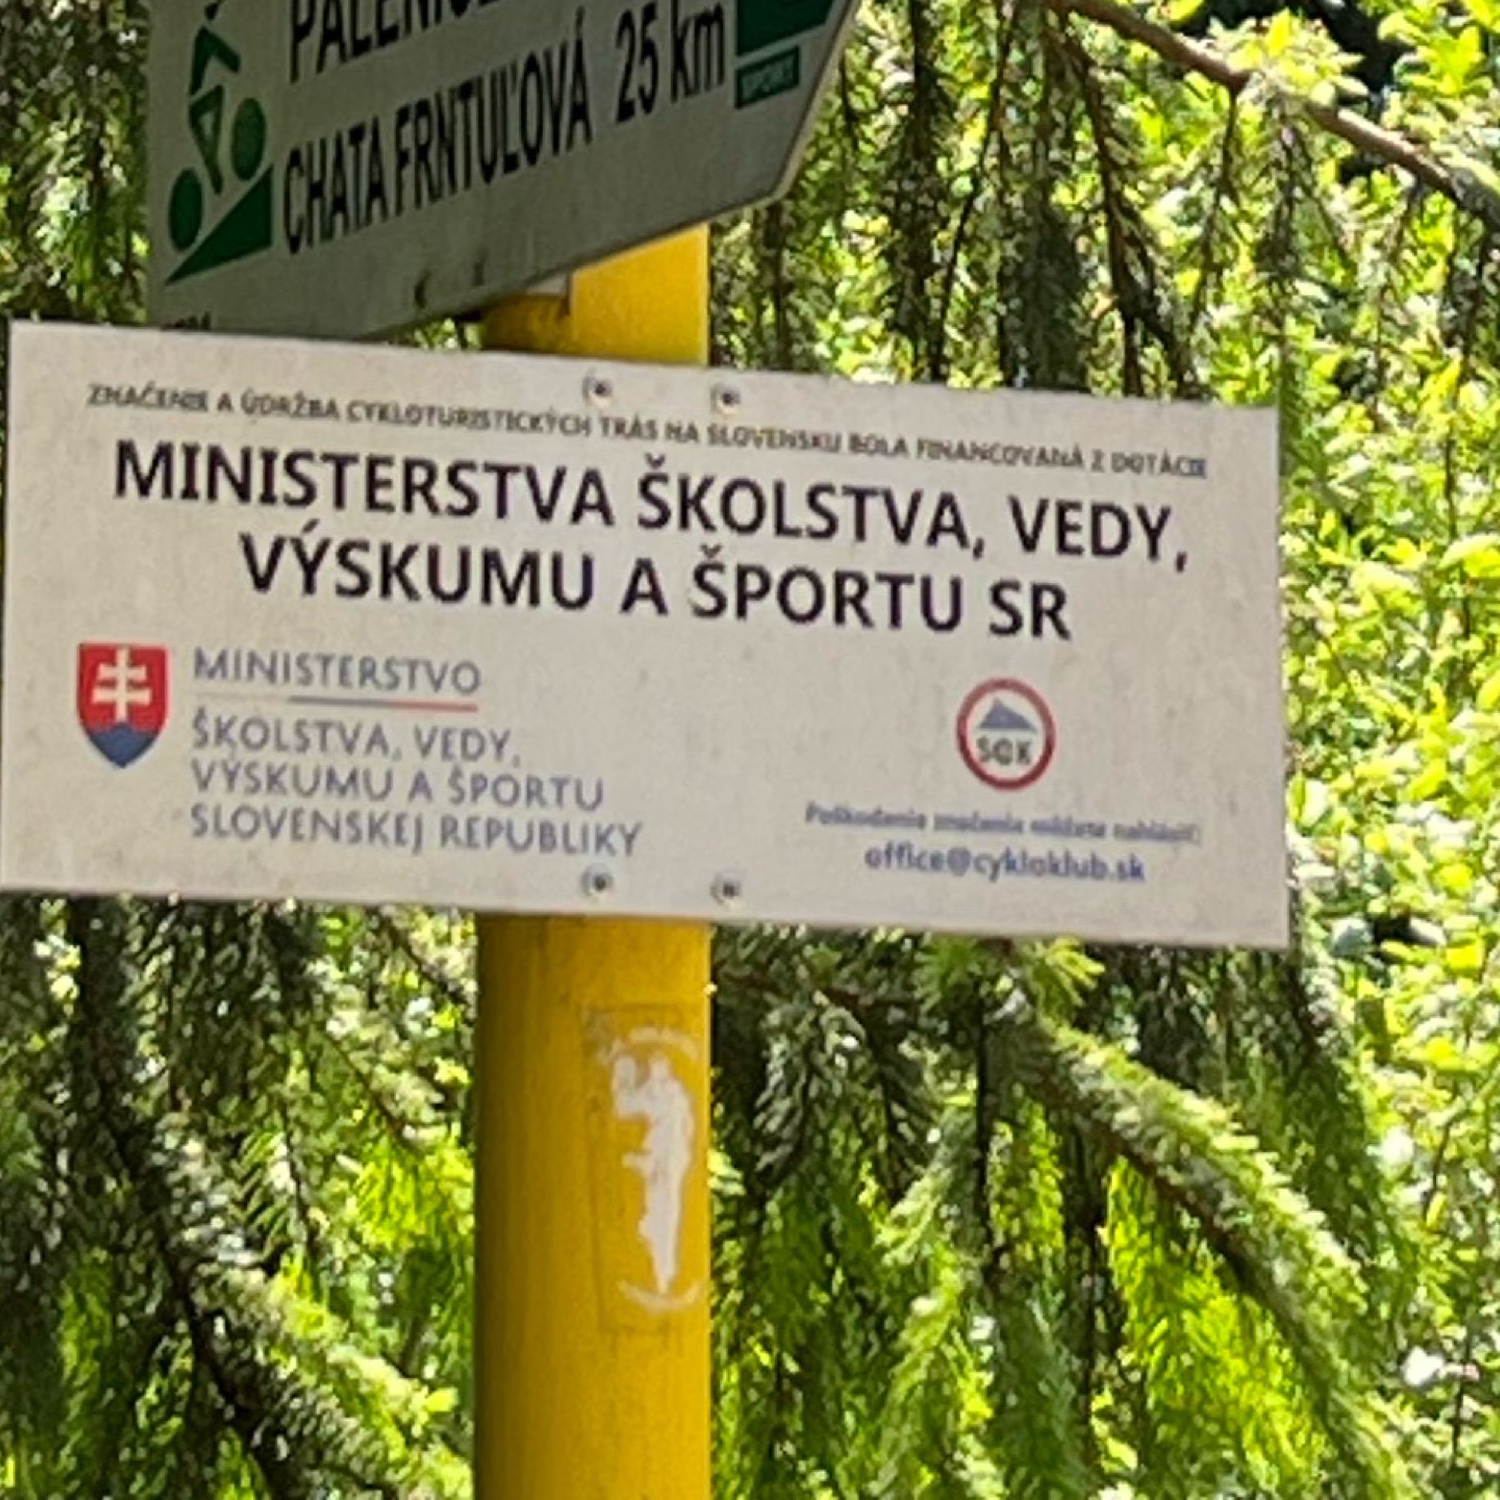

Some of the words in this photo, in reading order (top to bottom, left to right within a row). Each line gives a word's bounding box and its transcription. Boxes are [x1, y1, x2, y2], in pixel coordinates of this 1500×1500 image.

[283, 115, 389, 256] CHATA
[394, 5, 594, 218] FRNTUĽOVÁ
[615, 0, 660, 126] 25
[216, 390, 234, 413] A
[600, 411, 659, 441] TRÁS
[664, 418, 700, 444] NA
[706, 421, 842, 454] SLOVENSKU
[113, 438, 616, 528] MINISTERSTVA
[636, 451, 986, 561] ŠKOLSTVA,
[1007, 493, 1188, 573] VEDY,
[239, 518, 595, 612] VÝSKUMU
[618, 556, 670, 617] A
[691, 543, 965, 634] ŠPORTU
[988, 577, 1073, 642] SR
[193, 645, 482, 696] MINISTERSTVO
[191, 705, 404, 762] ŠKOLSTVA,
[412, 722, 522, 769] VEDY,
[191, 753, 394, 802] VÝSKUMU
[407, 769, 433, 802] A
[447, 765, 604, 813] ŠPORTU
[191, 803, 425, 856] SLOVENSKEJ
[439, 815, 644, 857] REPUBLIKY
[864, 840, 1147, 883] office@cykloklub.sk
